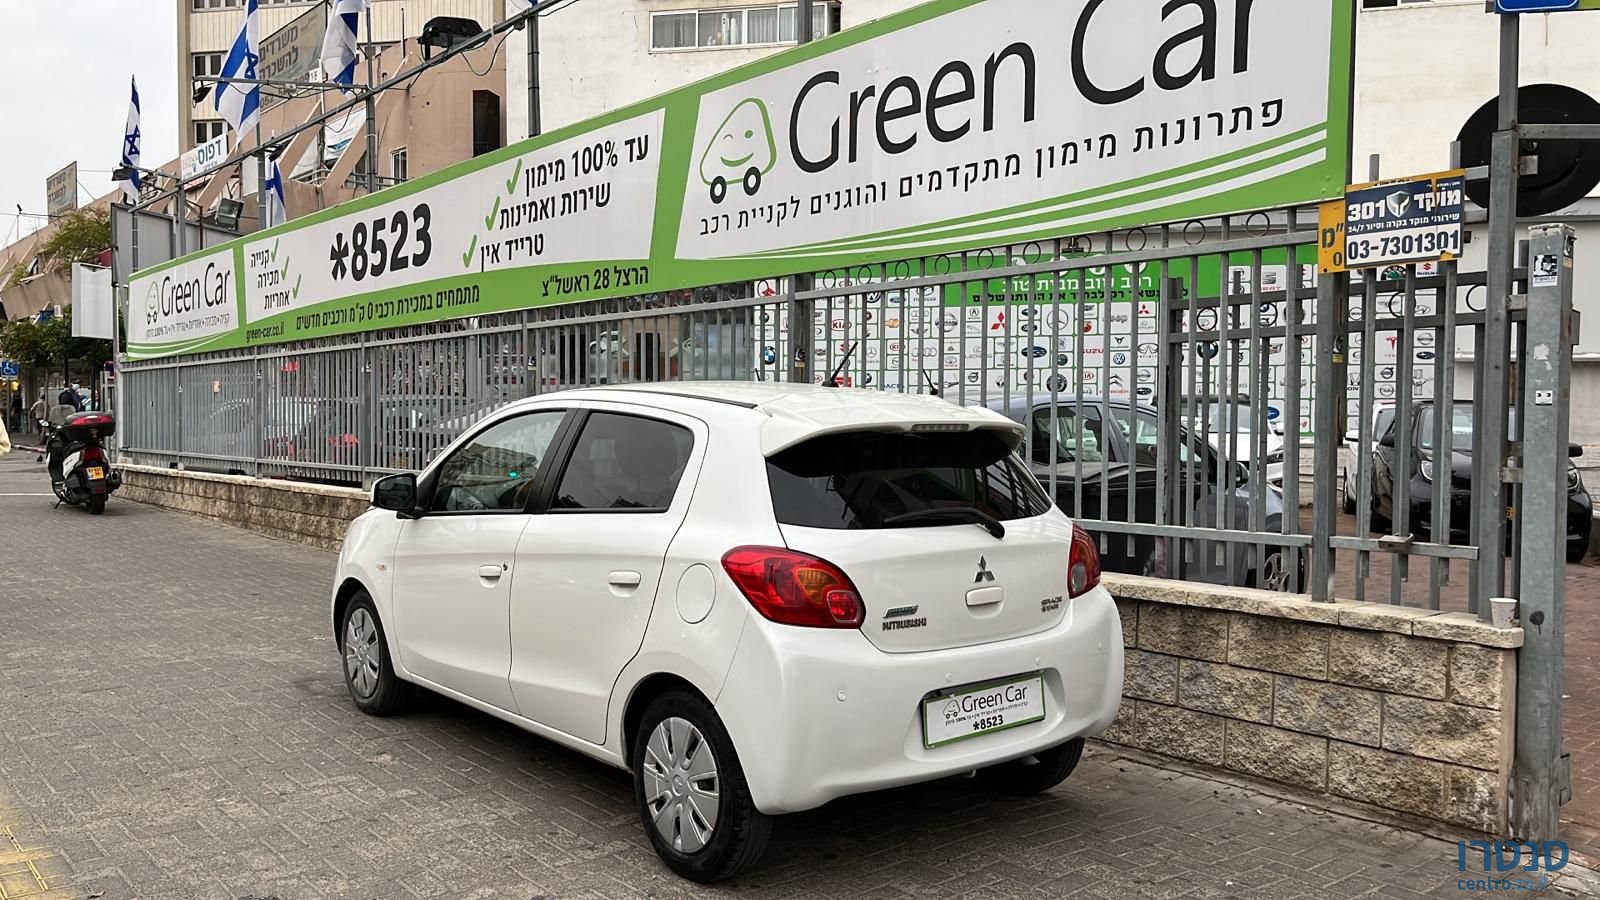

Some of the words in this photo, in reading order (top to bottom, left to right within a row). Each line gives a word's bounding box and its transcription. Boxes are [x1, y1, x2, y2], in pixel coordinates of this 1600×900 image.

[788, 41, 1036, 172] Green
[1070, 0, 1252, 104] Car
[1133, 98, 1283, 153] פתרונות
[198, 139, 221, 165] דפוס
[571, 140, 618, 177] 100%
[624, 134, 649, 163] עד
[1036, 133, 1117, 178] מימון
[525, 158, 565, 197] מימון
[900, 153, 1021, 198] מתקדמים
[560, 182, 611, 217] שירות
[811, 181, 886, 215] והוגנים
[1414, 187, 1461, 212] מוקד
[500, 194, 555, 230] ואמינות
[737, 195, 800, 229] לקניית
[1348, 199, 1385, 222] 301
[1409, 216, 1429, 227] מוקד
[700, 213, 730, 235] רכב
[1348, 224, 1364, 233] 24/7
[1366, 222, 1385, 231] וסיור
[1386, 219, 1408, 229] בקרה
[505, 233, 544, 260] טרייד
[1348, 230, 1459, 260] 03-7301301
[251, 249, 270, 270] קנייה
[480, 242, 500, 272] אין
[257, 269, 279, 289] מכירה
[542, 274, 590, 297] ראשל"צ
[593, 267, 610, 290] 28
[614, 266, 649, 288] הרצל
[1120, 276, 1152, 289] רב
[161, 275, 200, 317] Green
[204, 262, 231, 307] Car
[264, 290, 290, 311] אחריות
[436, 284, 480, 309] מתמחים
[350, 303, 365, 323] ק"מ
[367, 301, 373, 320] 0
[375, 300, 394, 319] רכבי
[397, 294, 433, 315] במכירת
[296, 312, 320, 331] חדשים
[323, 309, 347, 327] ורכבים
[246, 321, 285, 343] green-car.co.il
[882, 617, 927, 631] MITSUBISHI
[962, 692, 1003, 713] Green
[1005, 686, 1028, 703] Car
